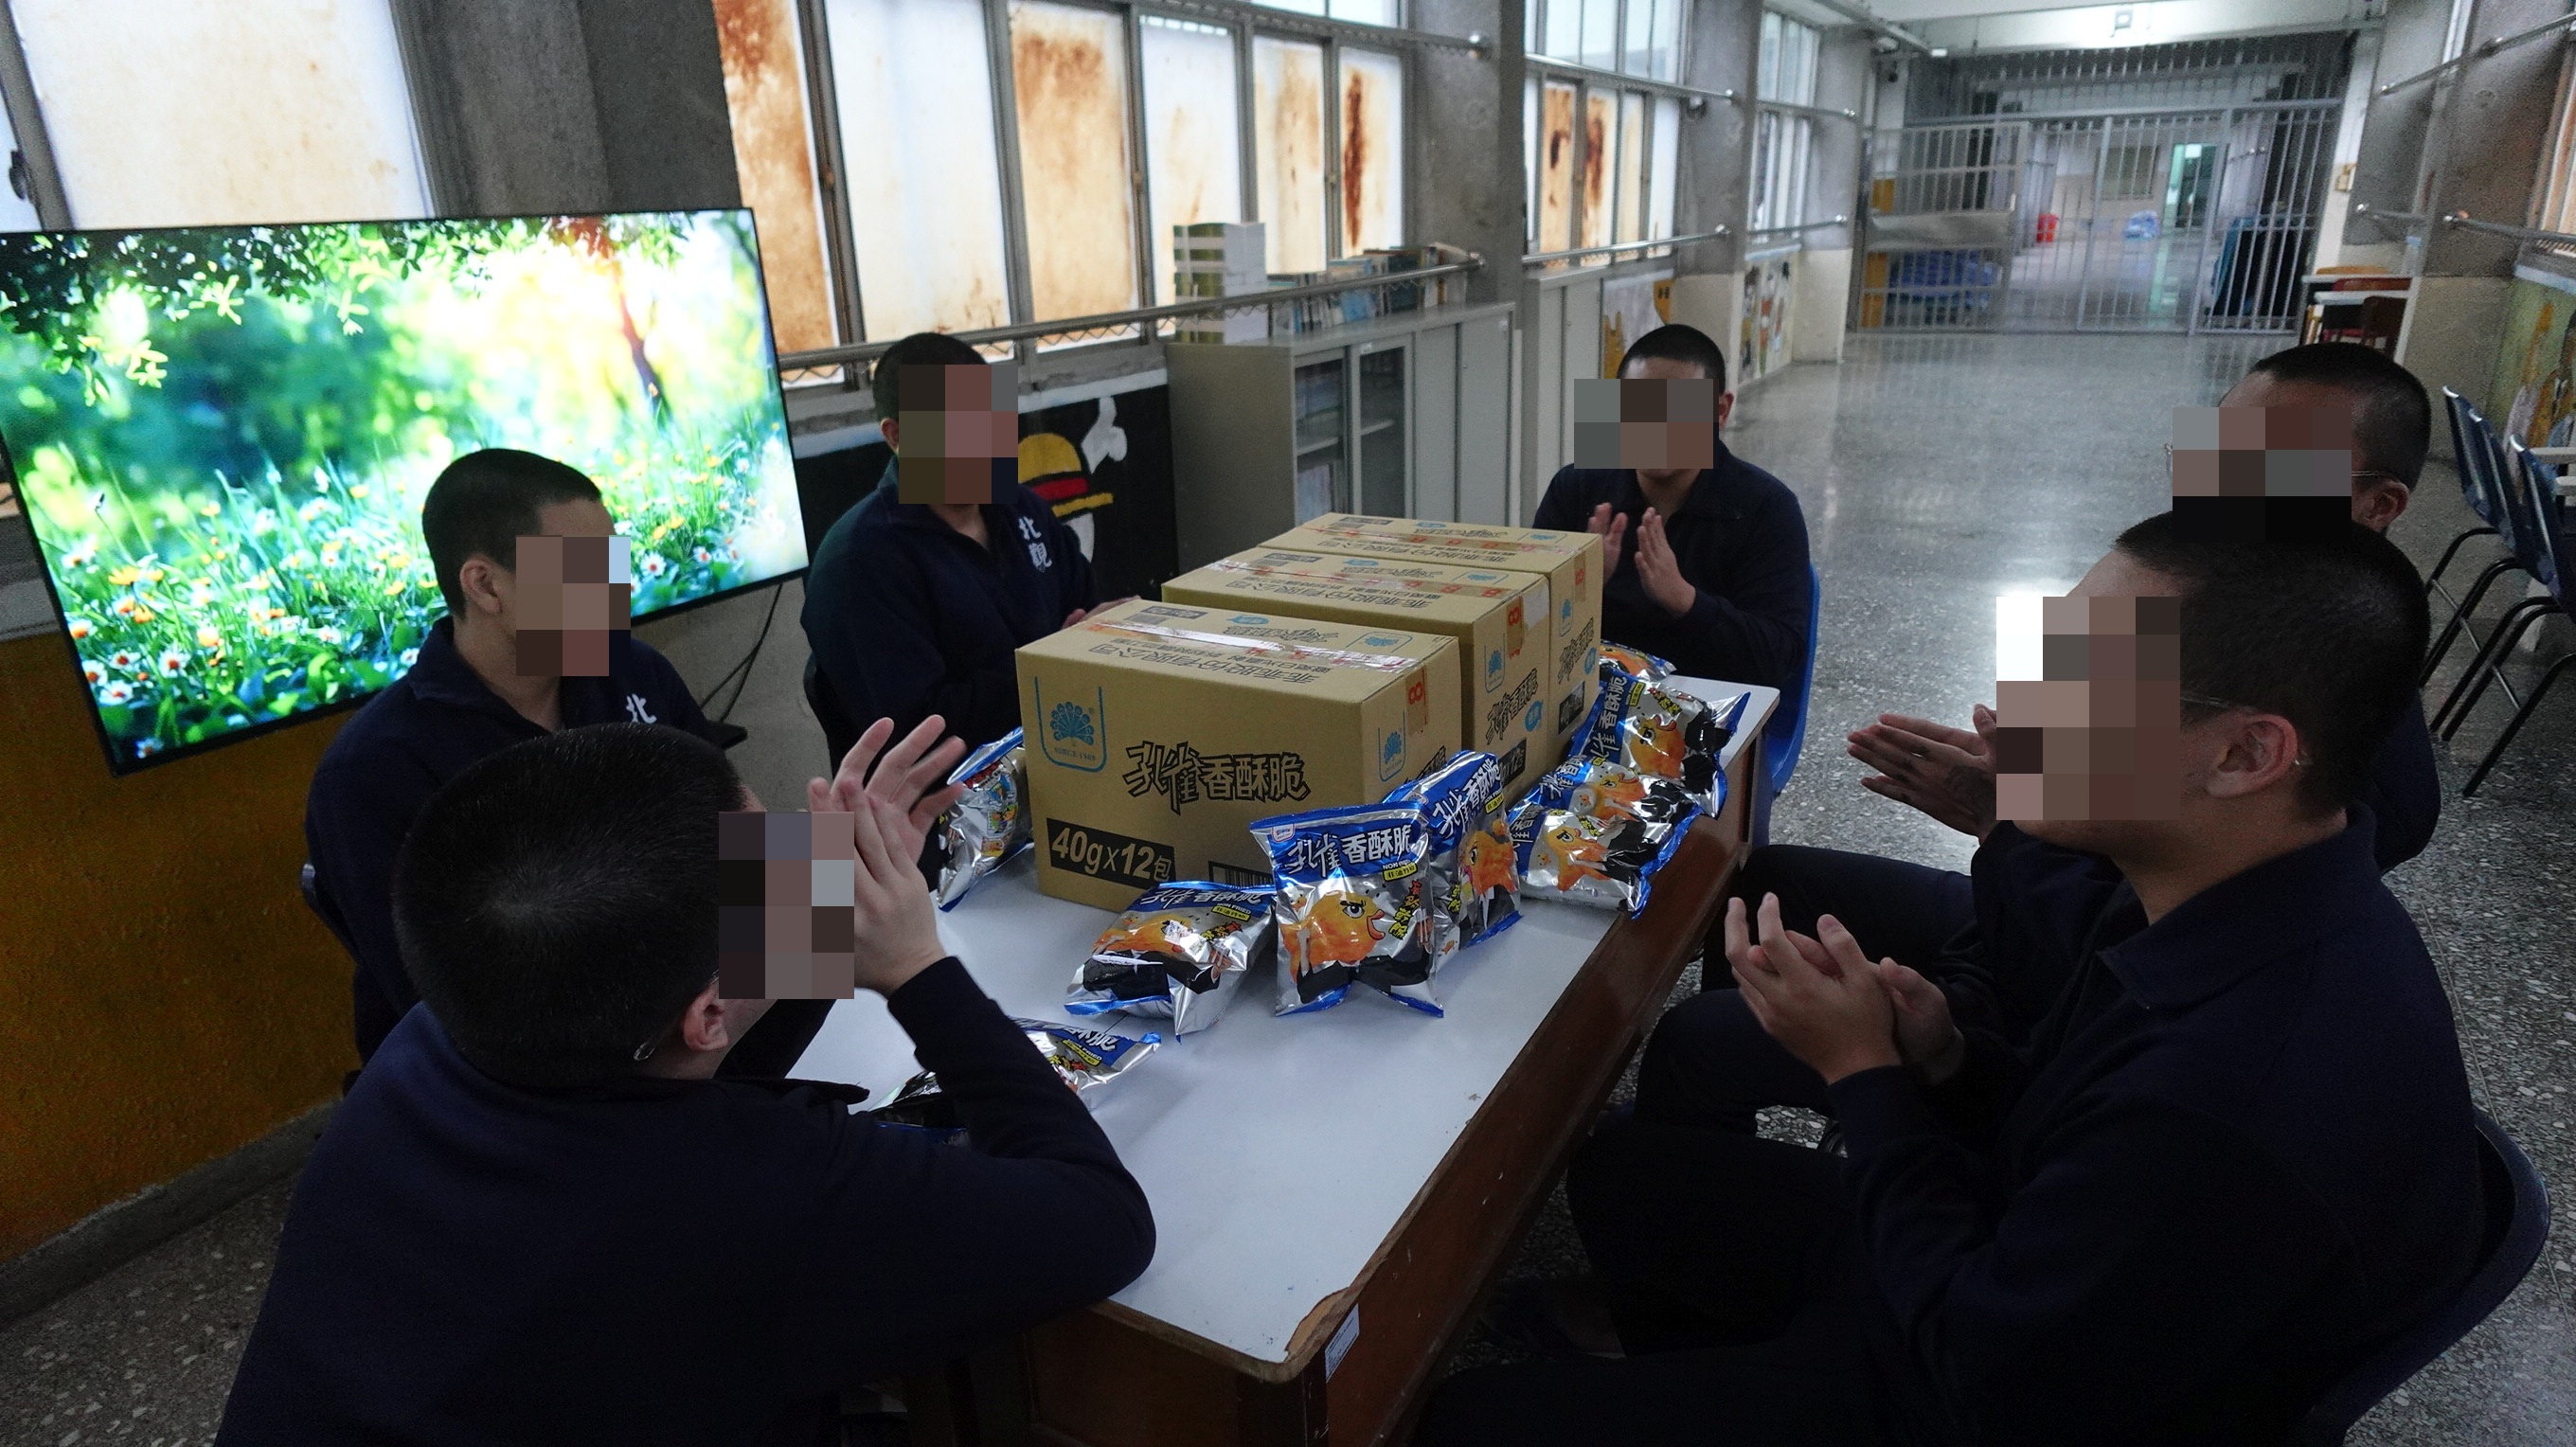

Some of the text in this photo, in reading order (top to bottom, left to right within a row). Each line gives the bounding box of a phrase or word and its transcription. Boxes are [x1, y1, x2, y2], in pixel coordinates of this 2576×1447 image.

[1089, 644, 1319, 684] 乖乖股份有限公司
[626, 693, 657, 724] 北
[1122, 740, 1312, 816] 孔雀香酥脆
[1383, 862, 1399, 870] NON
